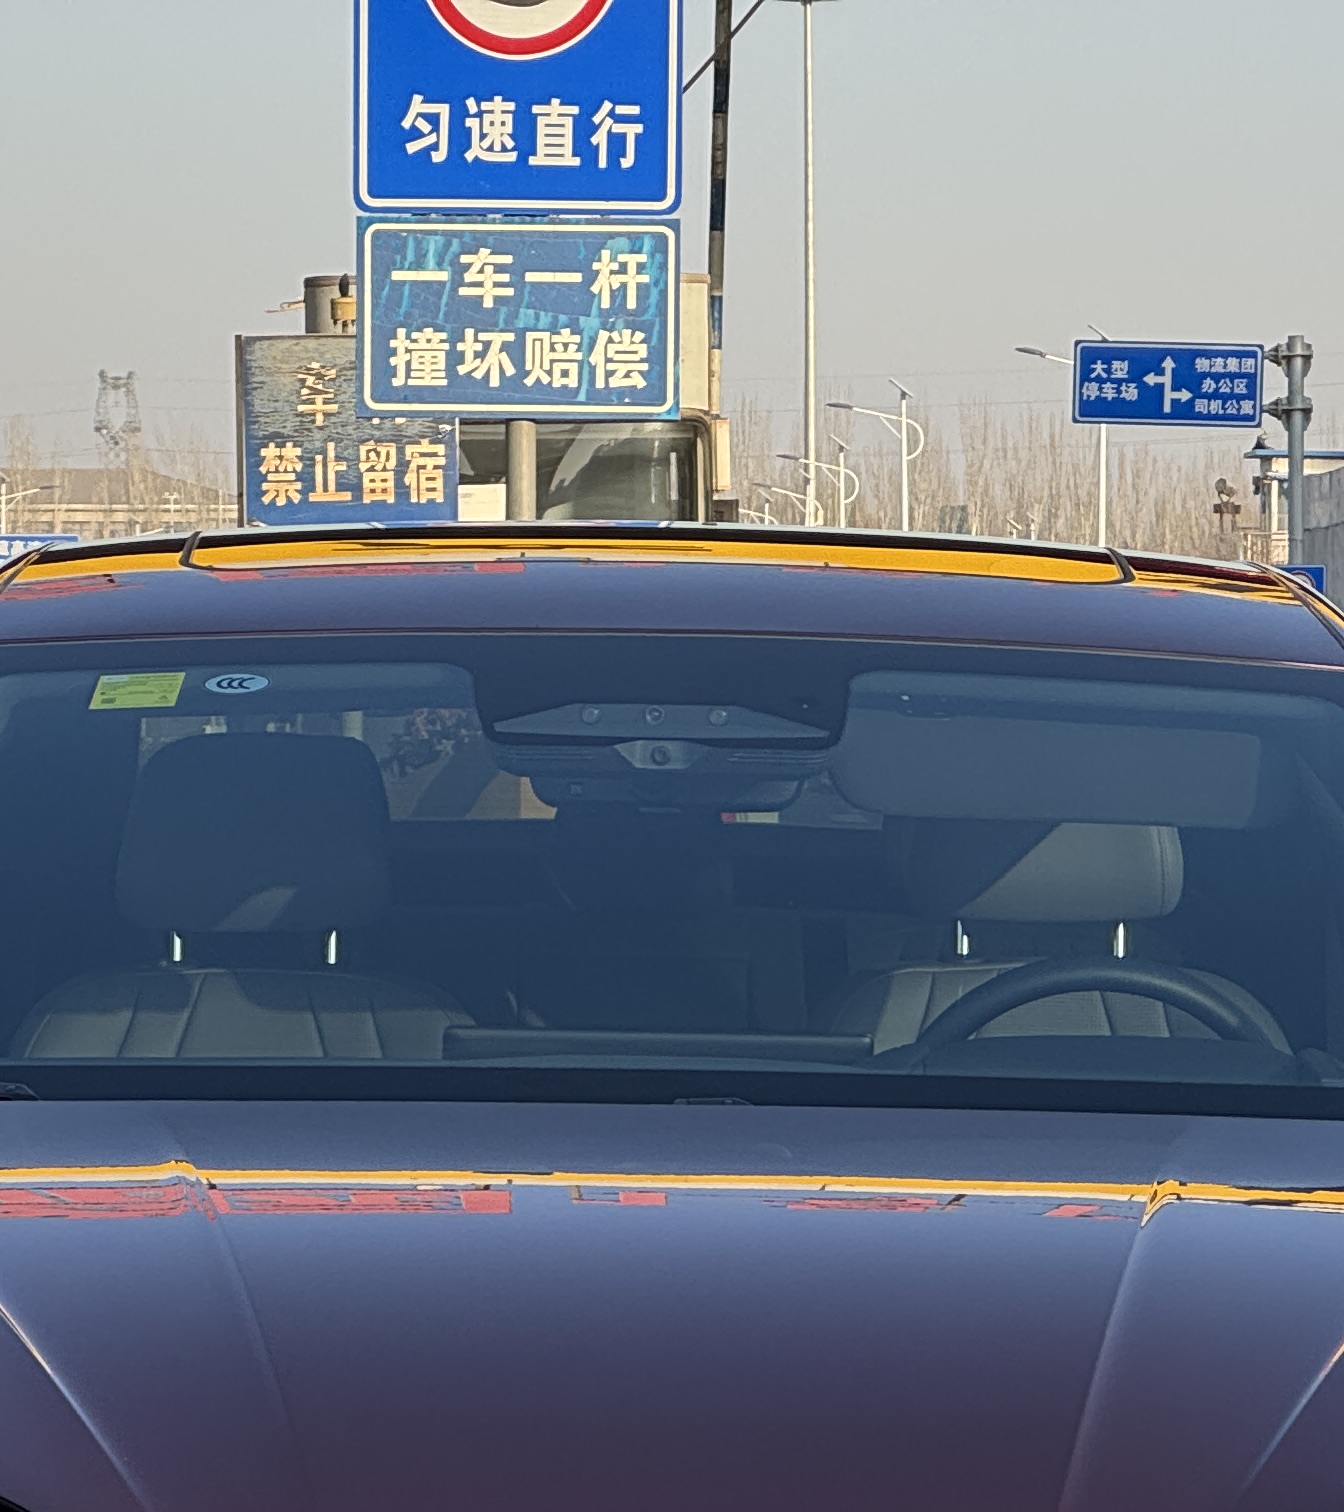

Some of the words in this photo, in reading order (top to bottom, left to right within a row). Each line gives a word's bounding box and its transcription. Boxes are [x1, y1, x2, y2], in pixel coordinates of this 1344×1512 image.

[401, 94, 644, 169] 匀速直行
[390, 248, 650, 310] 一车一杆
[389, 328, 650, 391] 撞坏赔偿
[1089, 359, 1129, 379] 大型
[1194, 357, 1255, 374] 物流集团
[1081, 381, 1139, 401] 停车场
[1201, 377, 1248, 395] 办公区
[1194, 398, 1255, 416] 司机公寓
[258, 439, 446, 506] 禁止留宿
